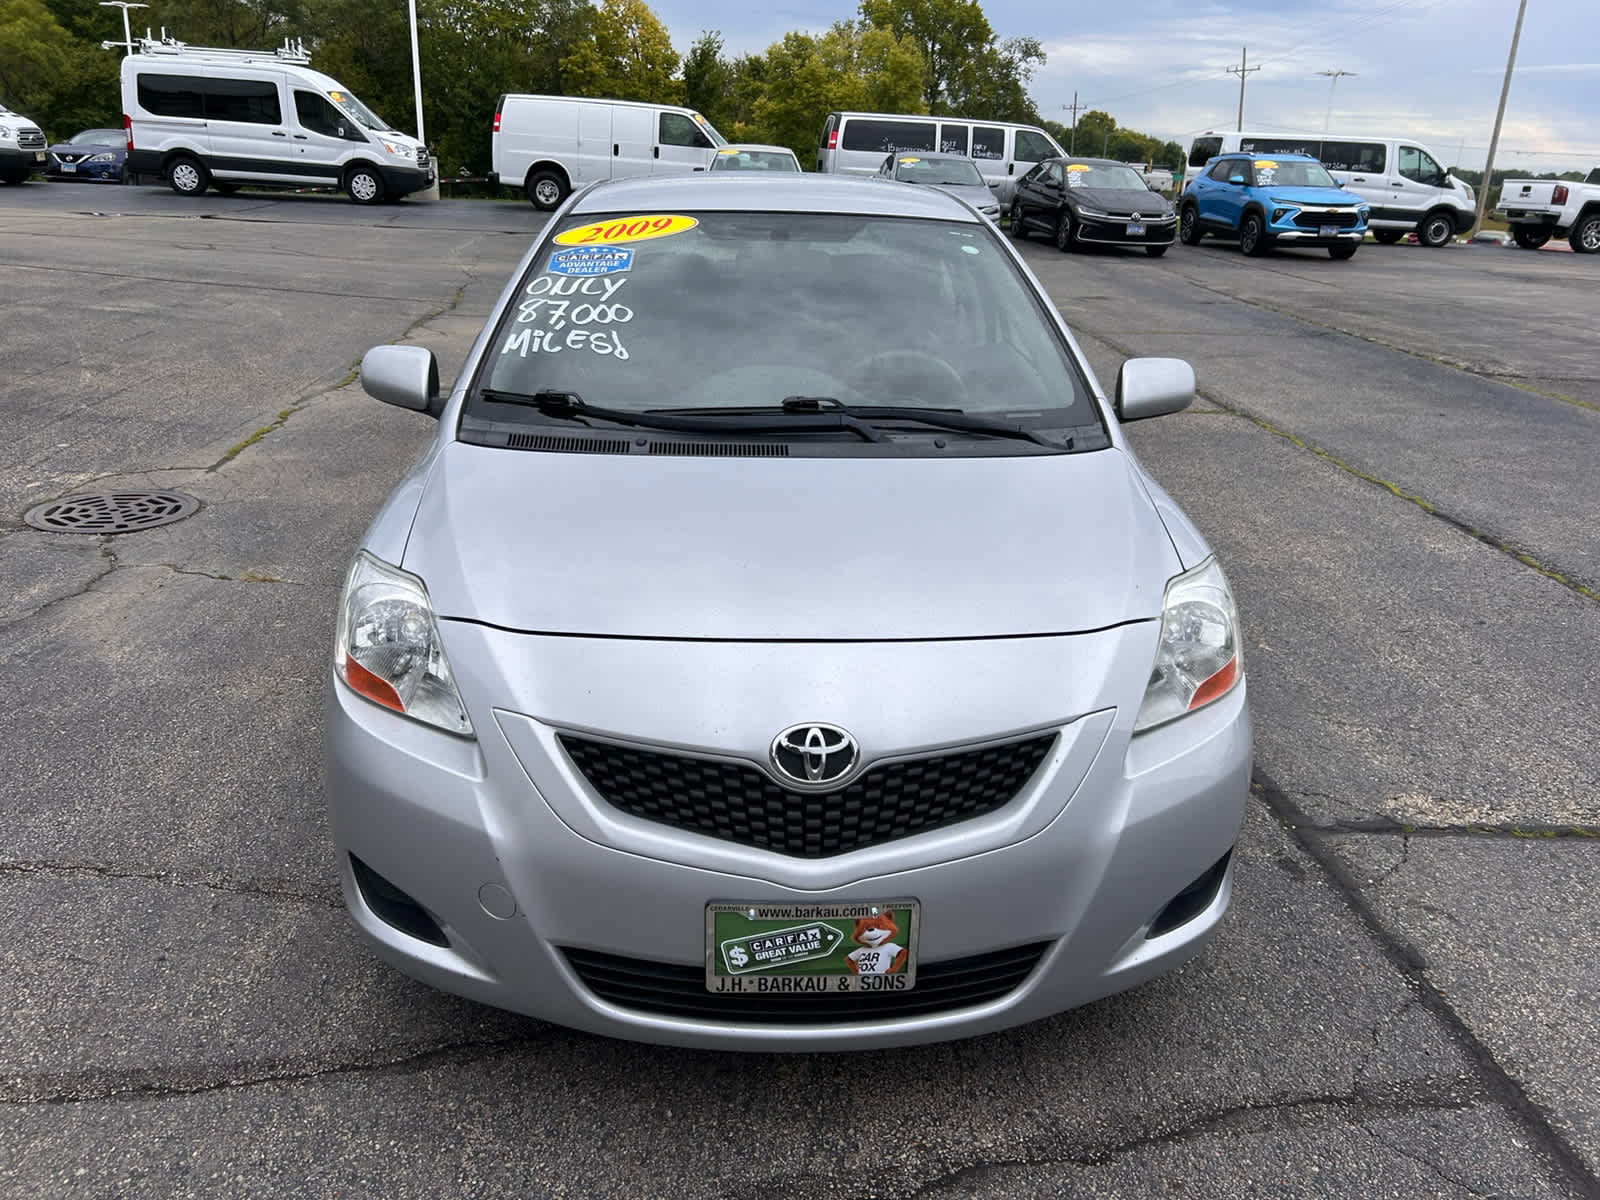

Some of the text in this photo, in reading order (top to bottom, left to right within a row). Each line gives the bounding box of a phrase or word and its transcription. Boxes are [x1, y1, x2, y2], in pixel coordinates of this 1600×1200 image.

[578, 217, 672, 242] 2009
[560, 260, 620, 268] ADVANTAGE
[526, 276, 627, 301] ONLY
[517, 298, 634, 330] 87,000
[758, 903, 869, 919] www.barkau.com
[750, 929, 820, 951] CARFAX
[755, 948, 787, 961] GREAT
[788, 940, 821, 953] VALUE
[716, 975, 906, 992] J.H. BARKAU & SONS
